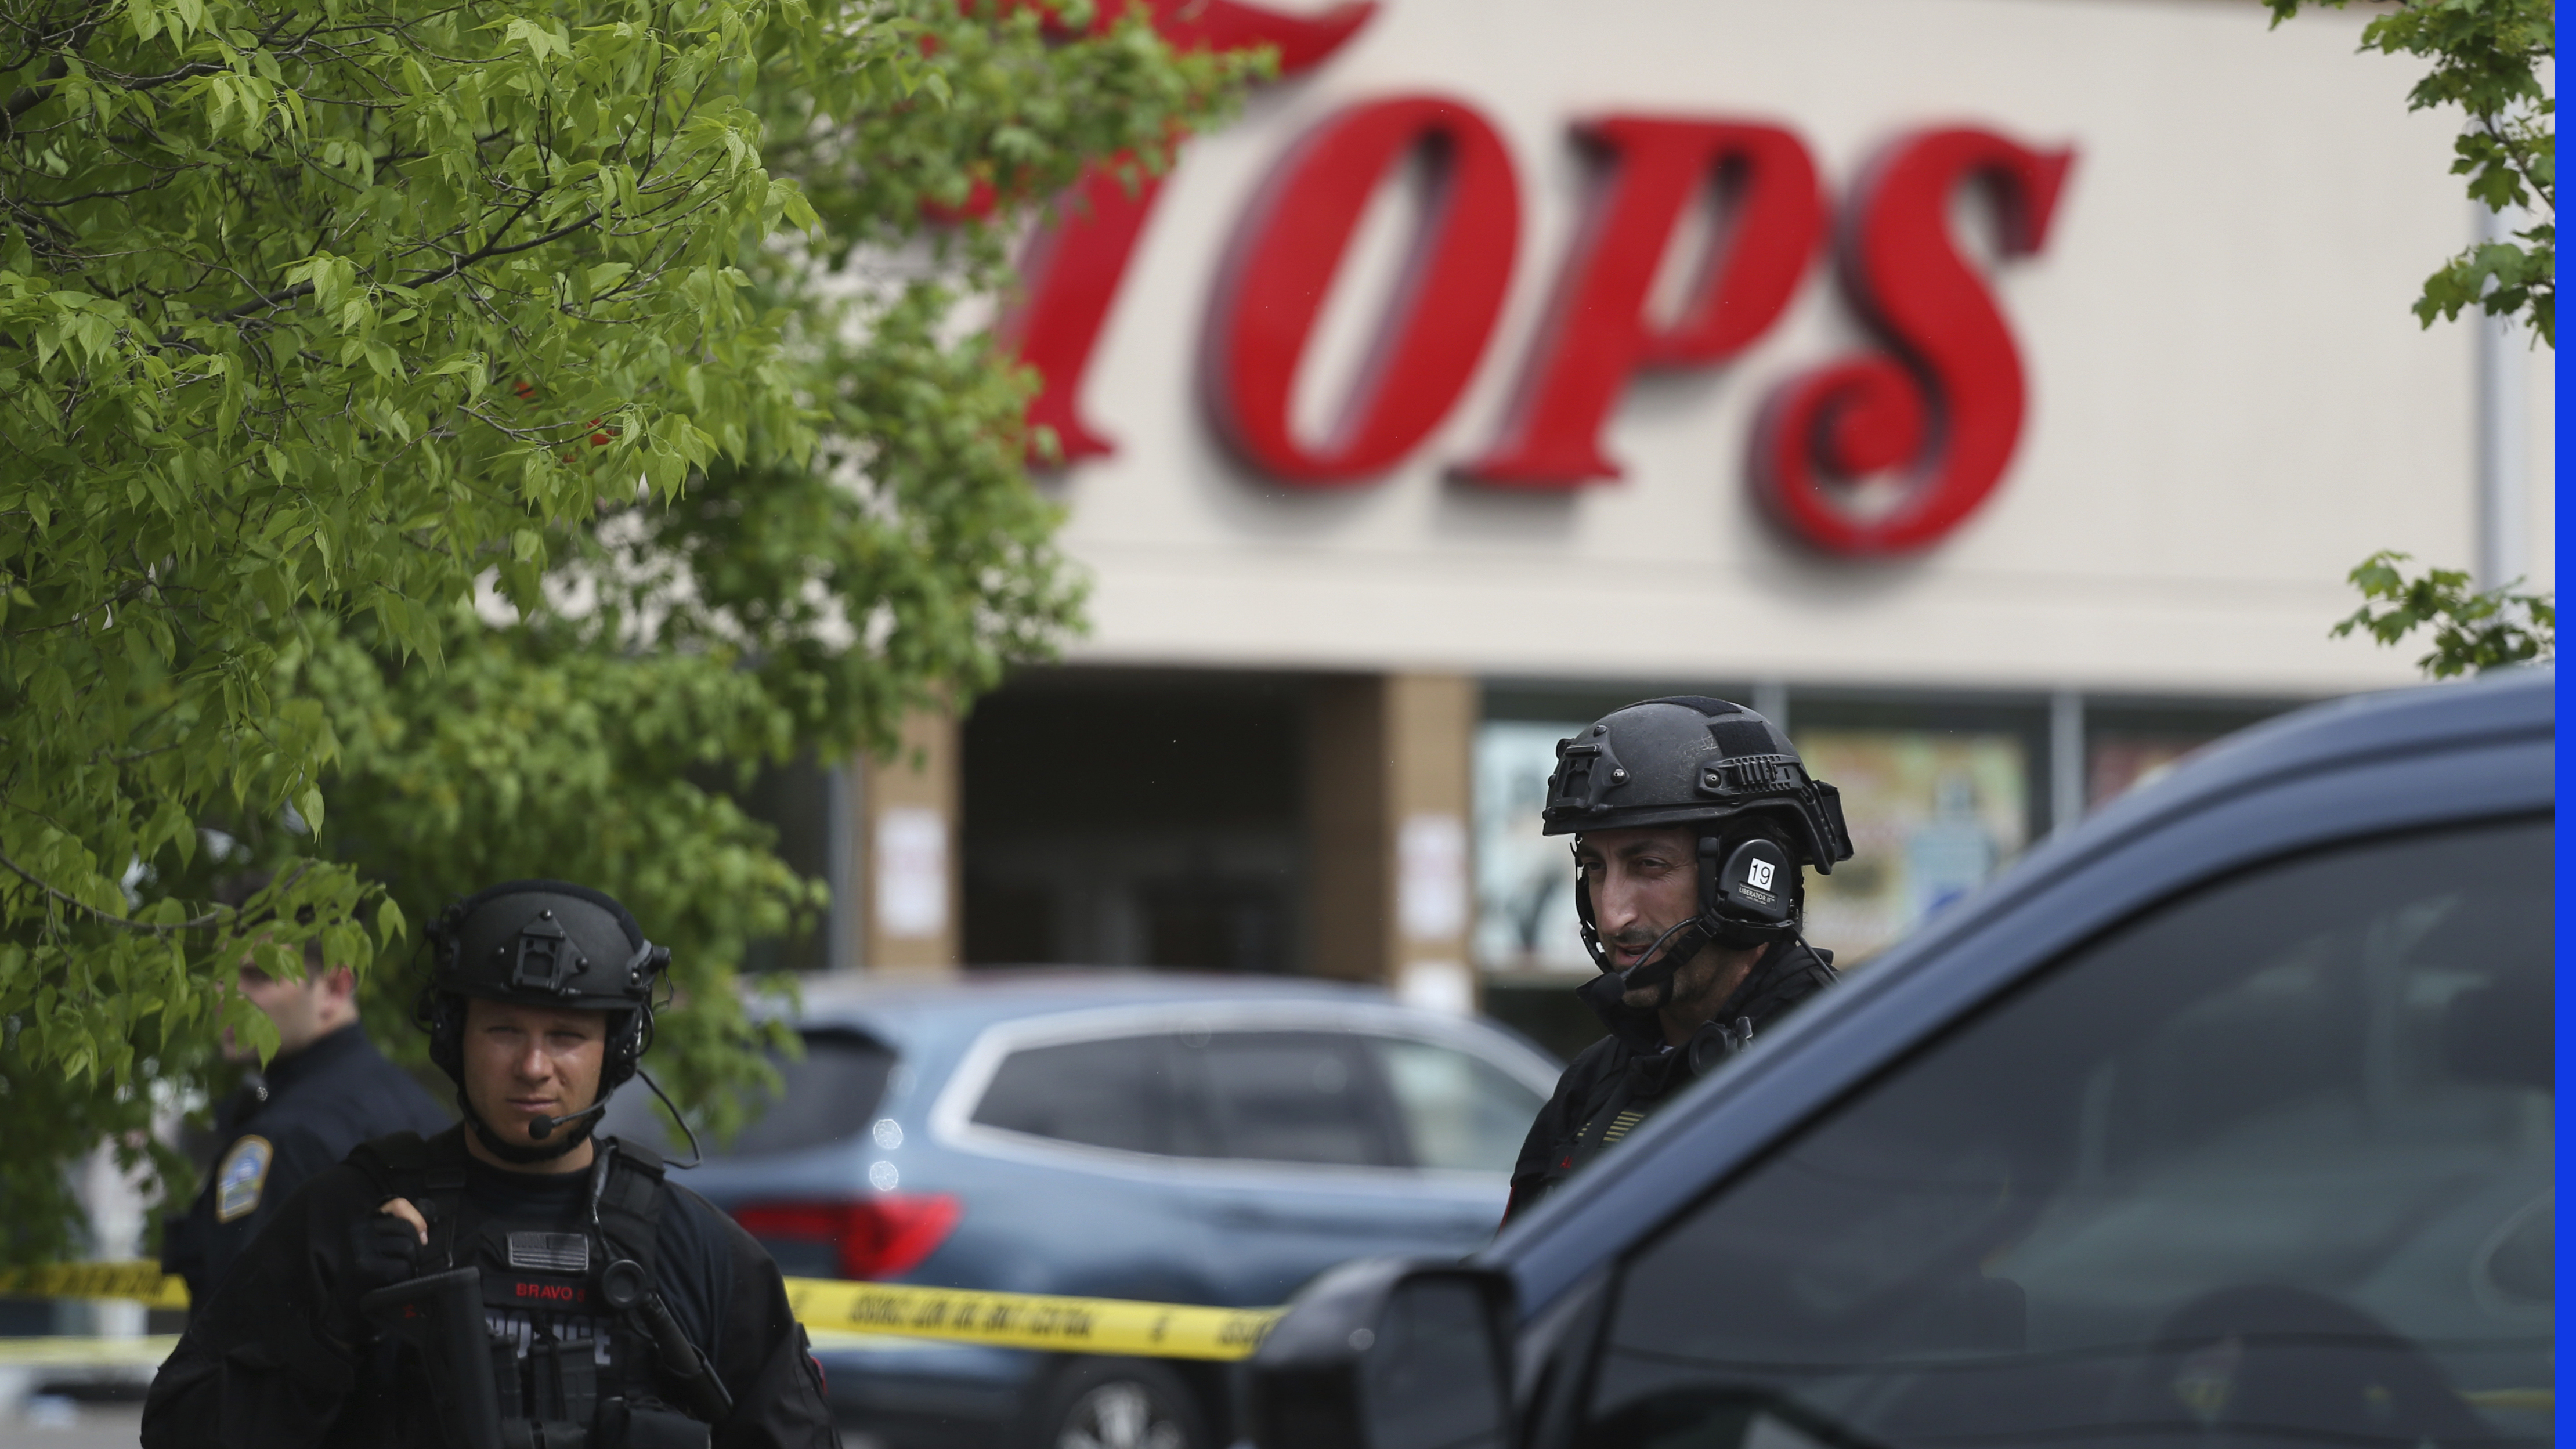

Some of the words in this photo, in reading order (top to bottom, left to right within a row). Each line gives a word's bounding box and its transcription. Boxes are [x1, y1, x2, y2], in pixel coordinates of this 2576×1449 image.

[1753, 863, 1771, 884] 19
[1739, 887, 1766, 901] LIBERATOR
[516, 1282, 573, 1301] BRAVO
[485, 1309, 610, 1364] POICE
